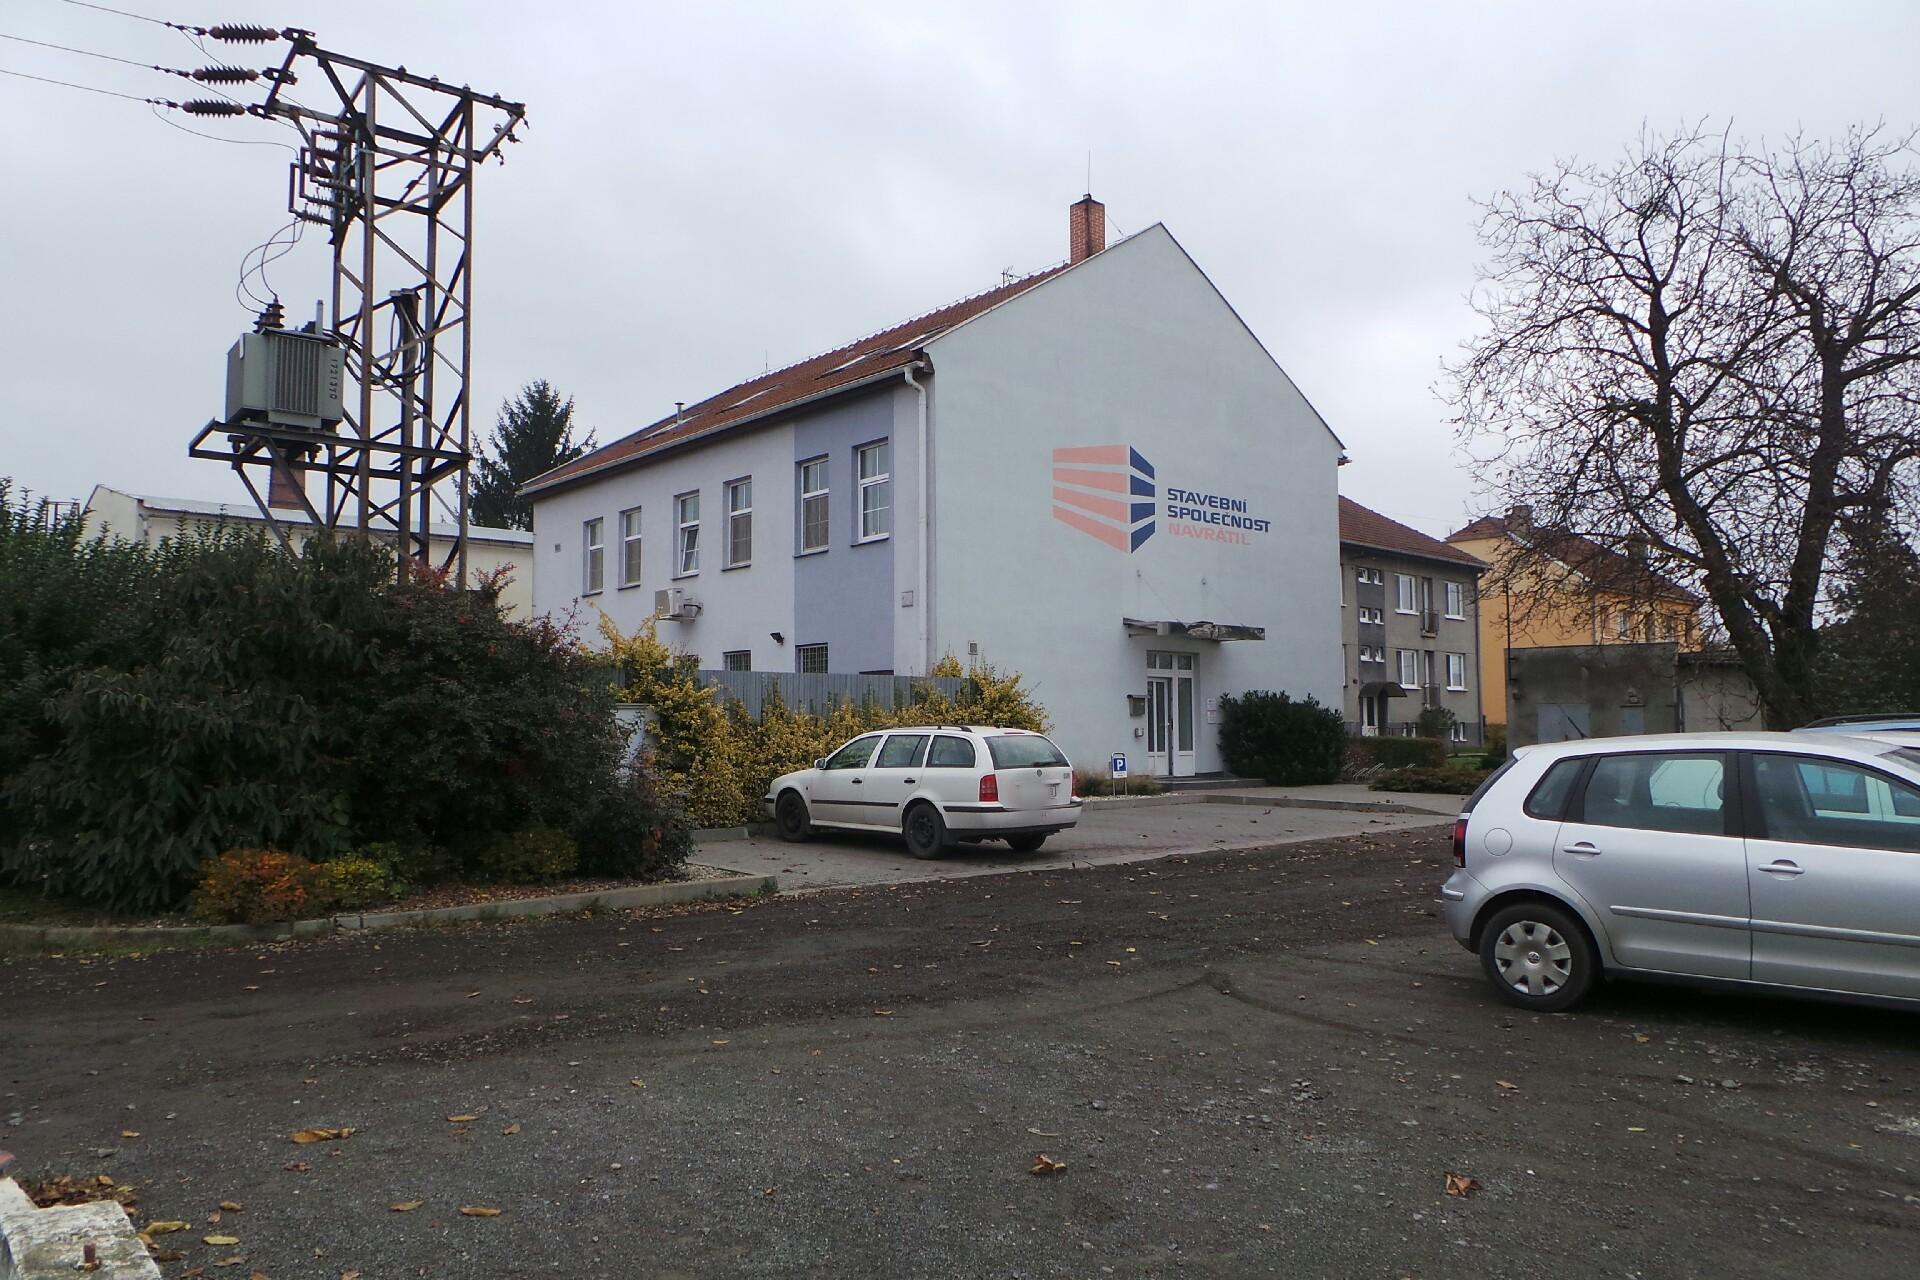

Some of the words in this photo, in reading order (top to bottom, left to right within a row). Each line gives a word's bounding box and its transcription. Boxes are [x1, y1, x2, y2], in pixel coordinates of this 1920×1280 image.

[1167, 487, 1247, 513] STAVEBNÍ
[1167, 504, 1271, 533] SPOLEČNOST
[1168, 523, 1251, 546] NAVRÁTIL
[1116, 759, 1124, 771] P
